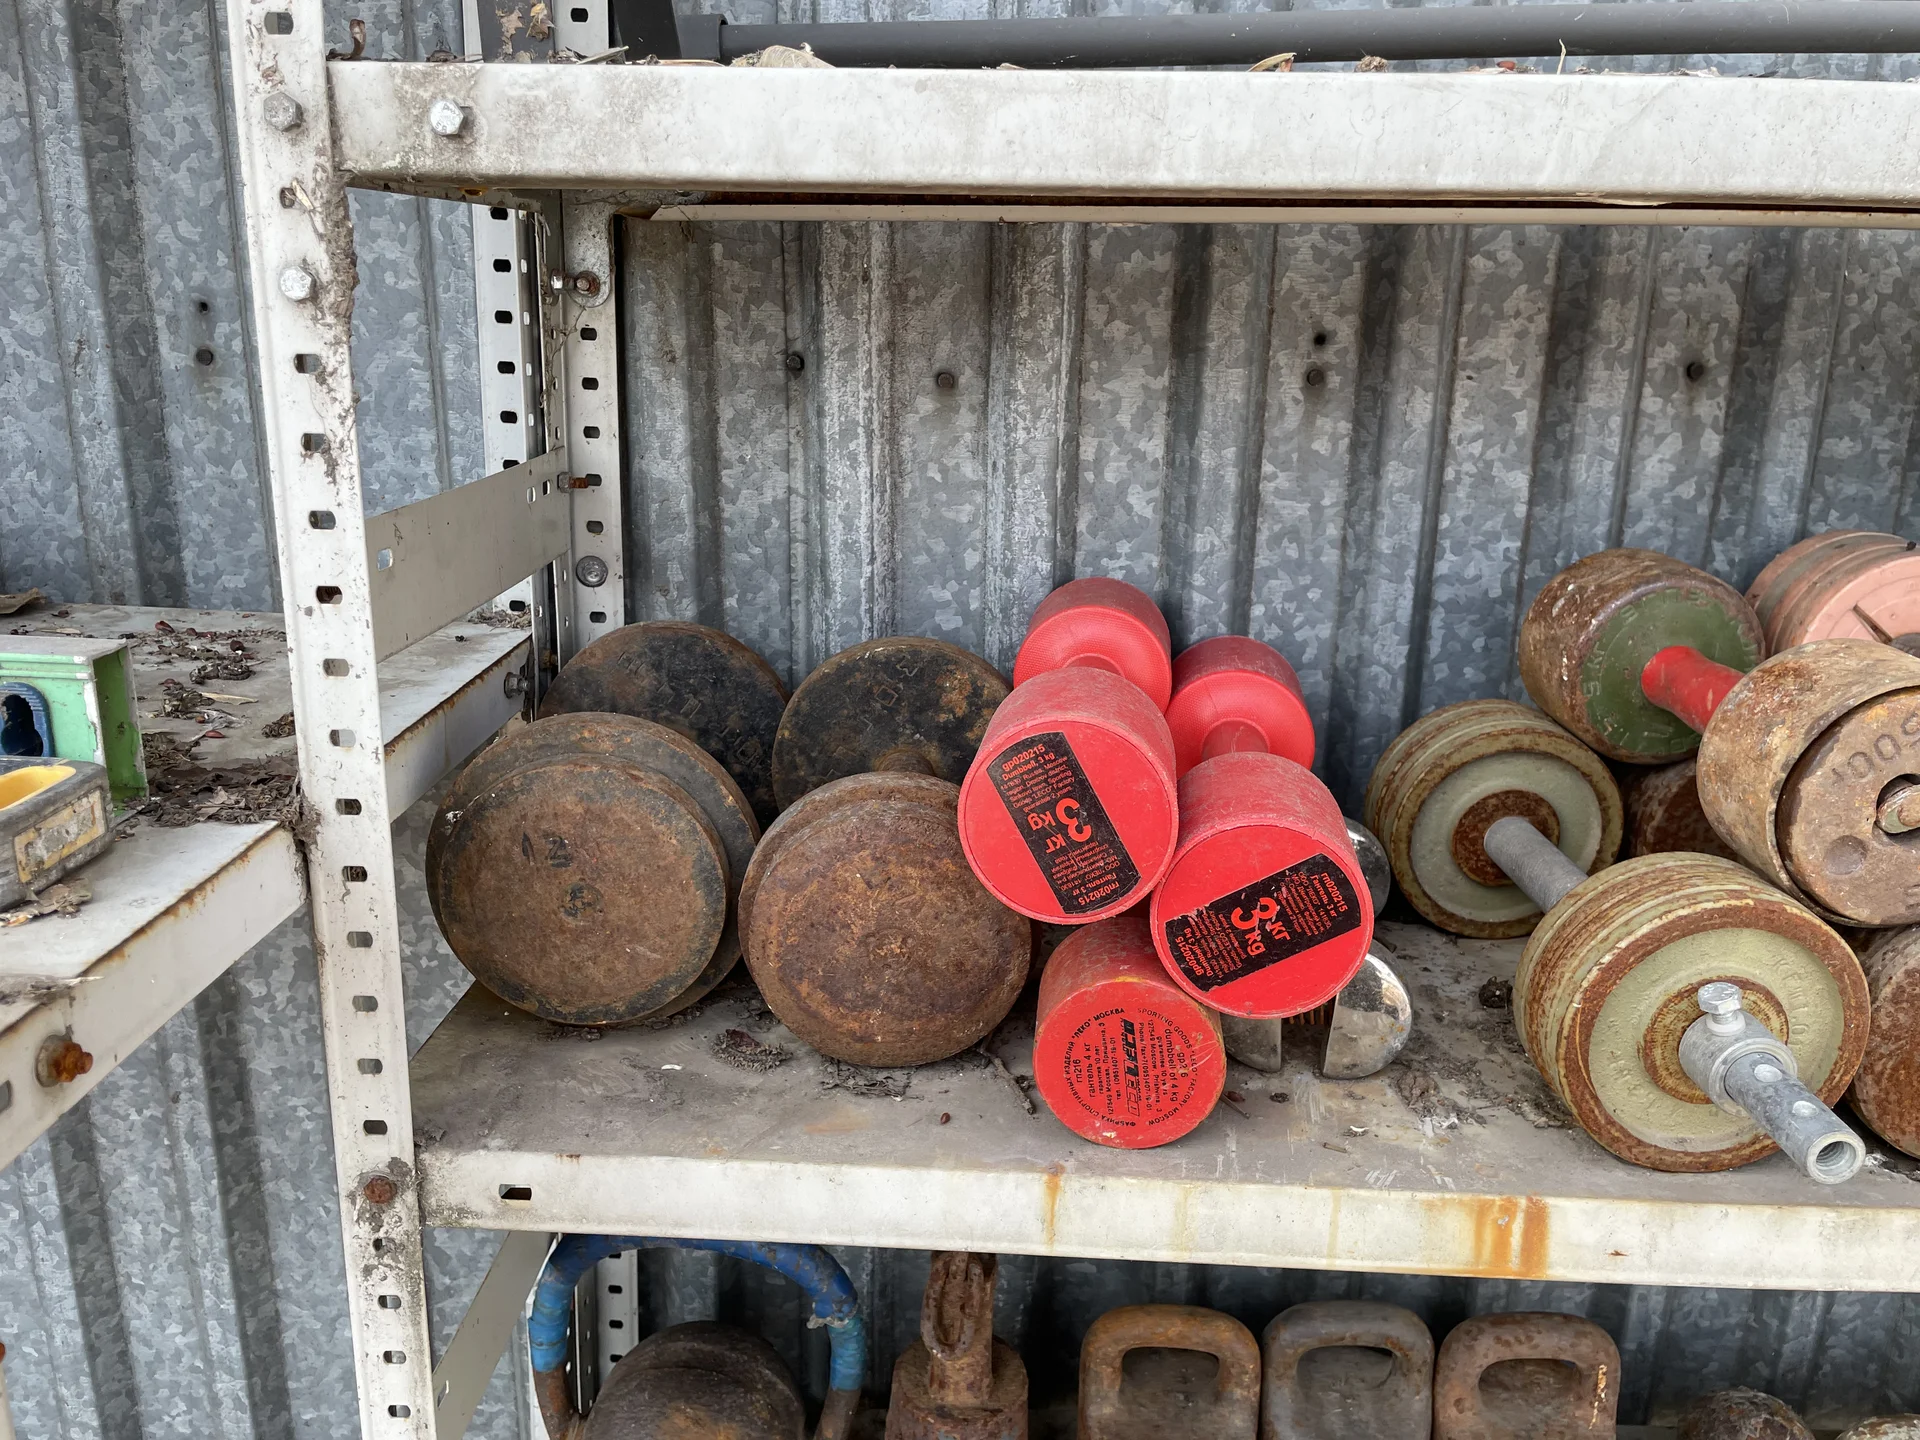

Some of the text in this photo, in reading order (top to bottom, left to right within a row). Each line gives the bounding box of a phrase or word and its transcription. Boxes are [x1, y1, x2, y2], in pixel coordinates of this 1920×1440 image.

[1002, 743, 1045, 772] gp020215
[1002, 760, 1038, 781] Dumbbell,
[1044, 752, 1055, 760] kg
[1027, 811, 1056, 830] kg
[1046, 798, 1092, 853] 3 кг
[1104, 860, 1120, 870] ООО
[1298, 871, 1309, 886] ООО
[1078, 881, 1119, 905] гп020215
[1321, 872, 1348, 912] гп020215
[1231, 897, 1290, 940] 3 кг
[1184, 928, 1192, 938] kg
[1244, 928, 1266, 956] kg
[1175, 936, 1204, 975] gp020215
[1093, 1007, 1125, 1022] МОСКВА
[1137, 1007, 1174, 1027] SPORTING
[1173, 1025, 1192, 1049] GOODS
[1164, 1028, 1176, 1070] dumbbell
[1095, 1056, 1101, 1065] 10
[1177, 1052, 1188, 1078] gp26
[1160, 1068, 1167, 1077] 10
[1169, 1071, 1178, 1081] of
[1065, 1073, 1100, 1117] СПОРТИВНЫХ
[1170, 1091, 1180, 1102] kg
[1101, 1115, 1136, 1127] ФАБРИКА
[1148, 1107, 1180, 1126] MOSCOW
